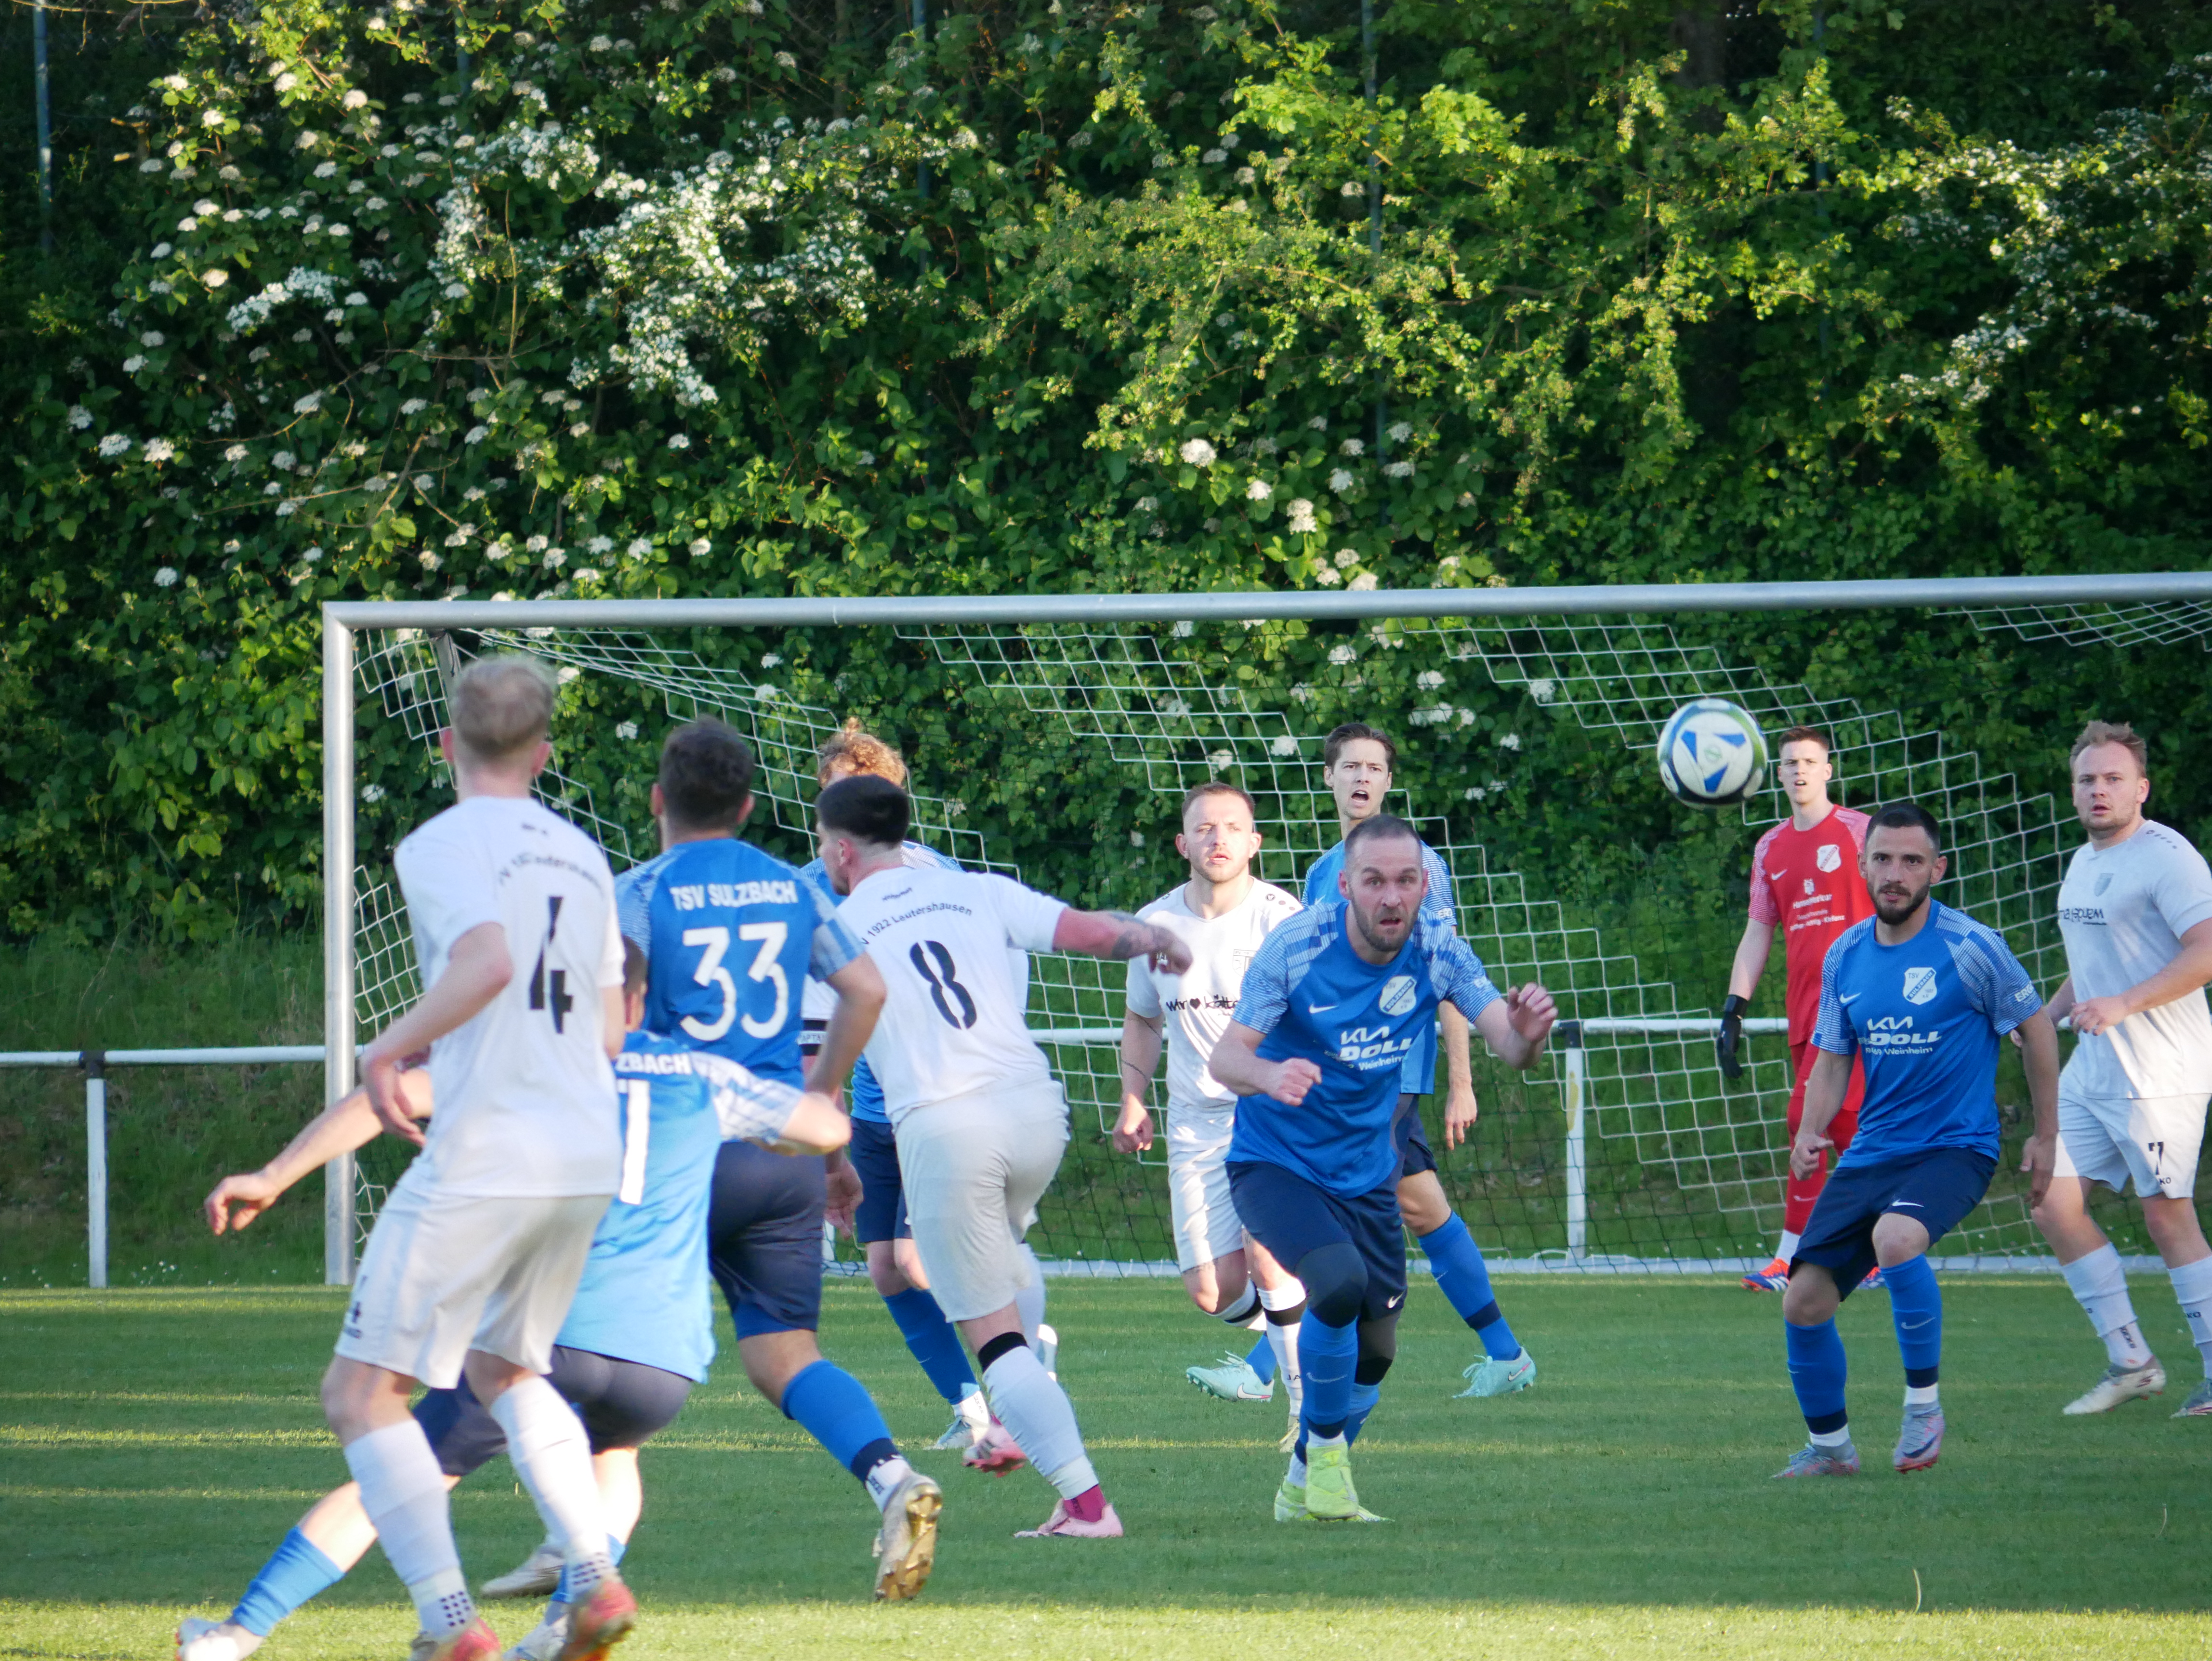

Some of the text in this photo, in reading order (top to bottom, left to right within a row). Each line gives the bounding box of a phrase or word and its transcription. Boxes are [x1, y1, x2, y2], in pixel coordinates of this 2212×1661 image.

[670, 880, 799, 910] TSV SULZBACH
[868, 919, 891, 936] 1922
[892, 902, 972, 923] Leutershausen
[529, 896, 573, 1034] 4
[680, 922, 789, 1041] 33
[909, 940, 977, 1030] 8
[1909, 972, 1933, 998] SULZBACH
[1341, 1026, 1389, 1045] KIA
[1867, 1016, 1913, 1030] KIA
[1337, 1038, 1412, 1061] DOLL
[1869, 1031, 1941, 1045] DOLL
[1884, 1047, 1933, 1055] Weinheim
[2148, 1142, 2164, 1175] 7
